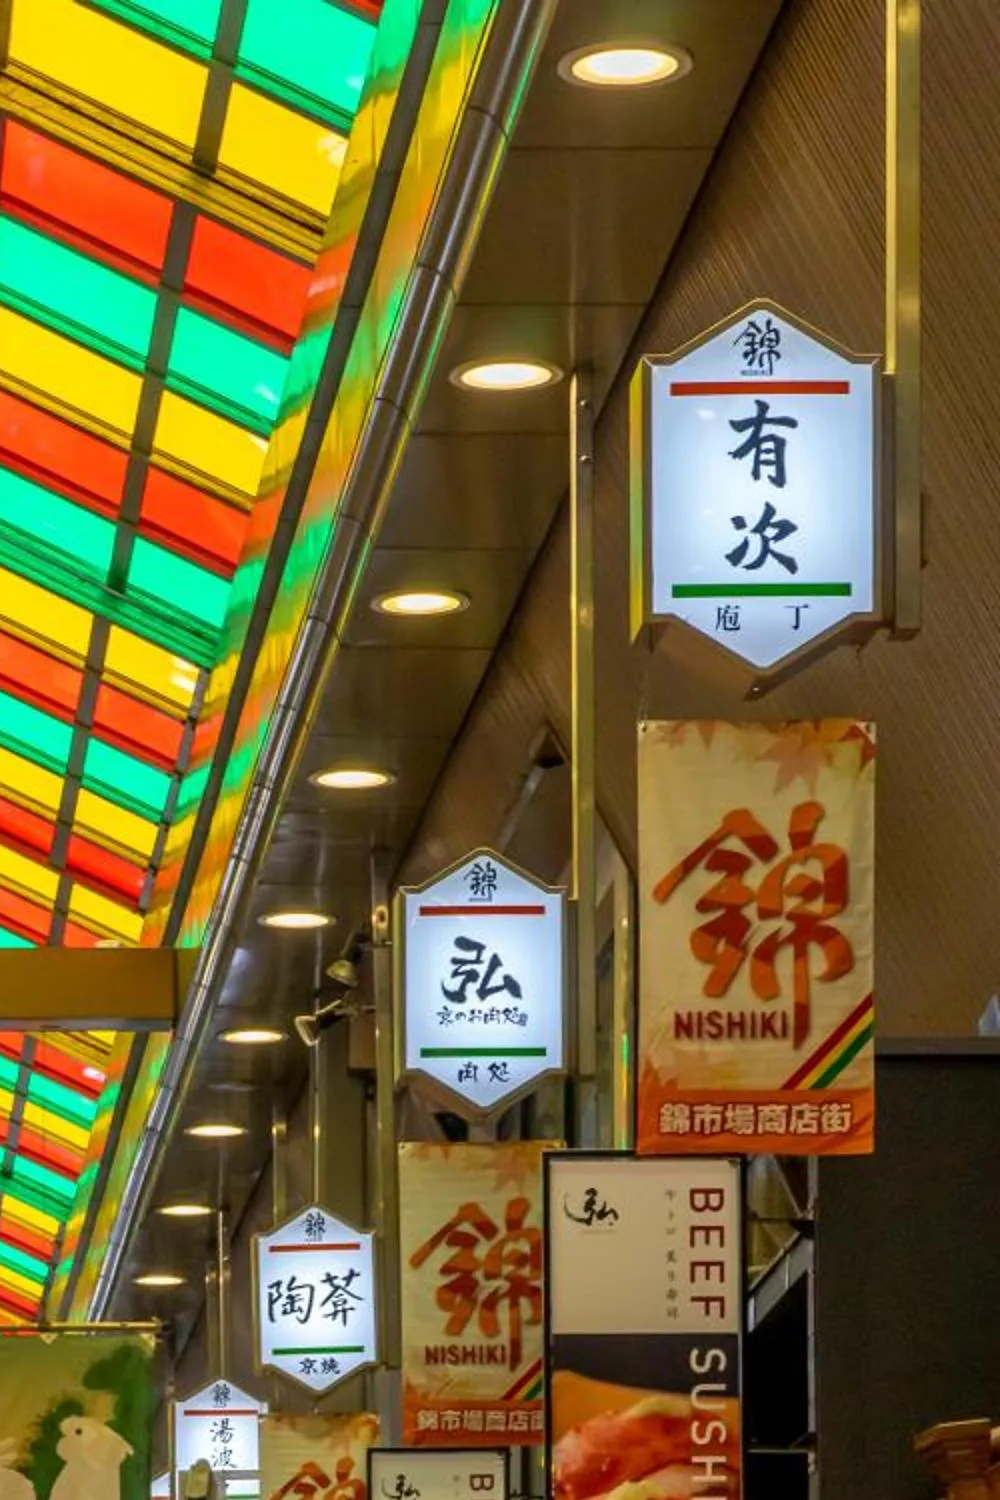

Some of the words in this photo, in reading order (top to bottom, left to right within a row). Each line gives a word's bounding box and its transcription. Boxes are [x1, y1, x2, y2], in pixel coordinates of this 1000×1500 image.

[733, 319, 781, 376] 錦
[725, 400, 799, 575] 有次
[715, 603, 810, 632] 庖丁
[464, 862, 498, 900] 錦
[653, 801, 856, 1050] 錦
[441, 935, 523, 1003] 弘
[674, 1010, 788, 1041] NISHIKI
[458, 1061, 511, 1084] 肉処
[659, 1103, 852, 1136] 錦市場商店街
[689, 1187, 726, 1319] BEEF
[298, 1356, 342, 1376] 京焼
[424, 1344, 508, 1367] NISHIKI
